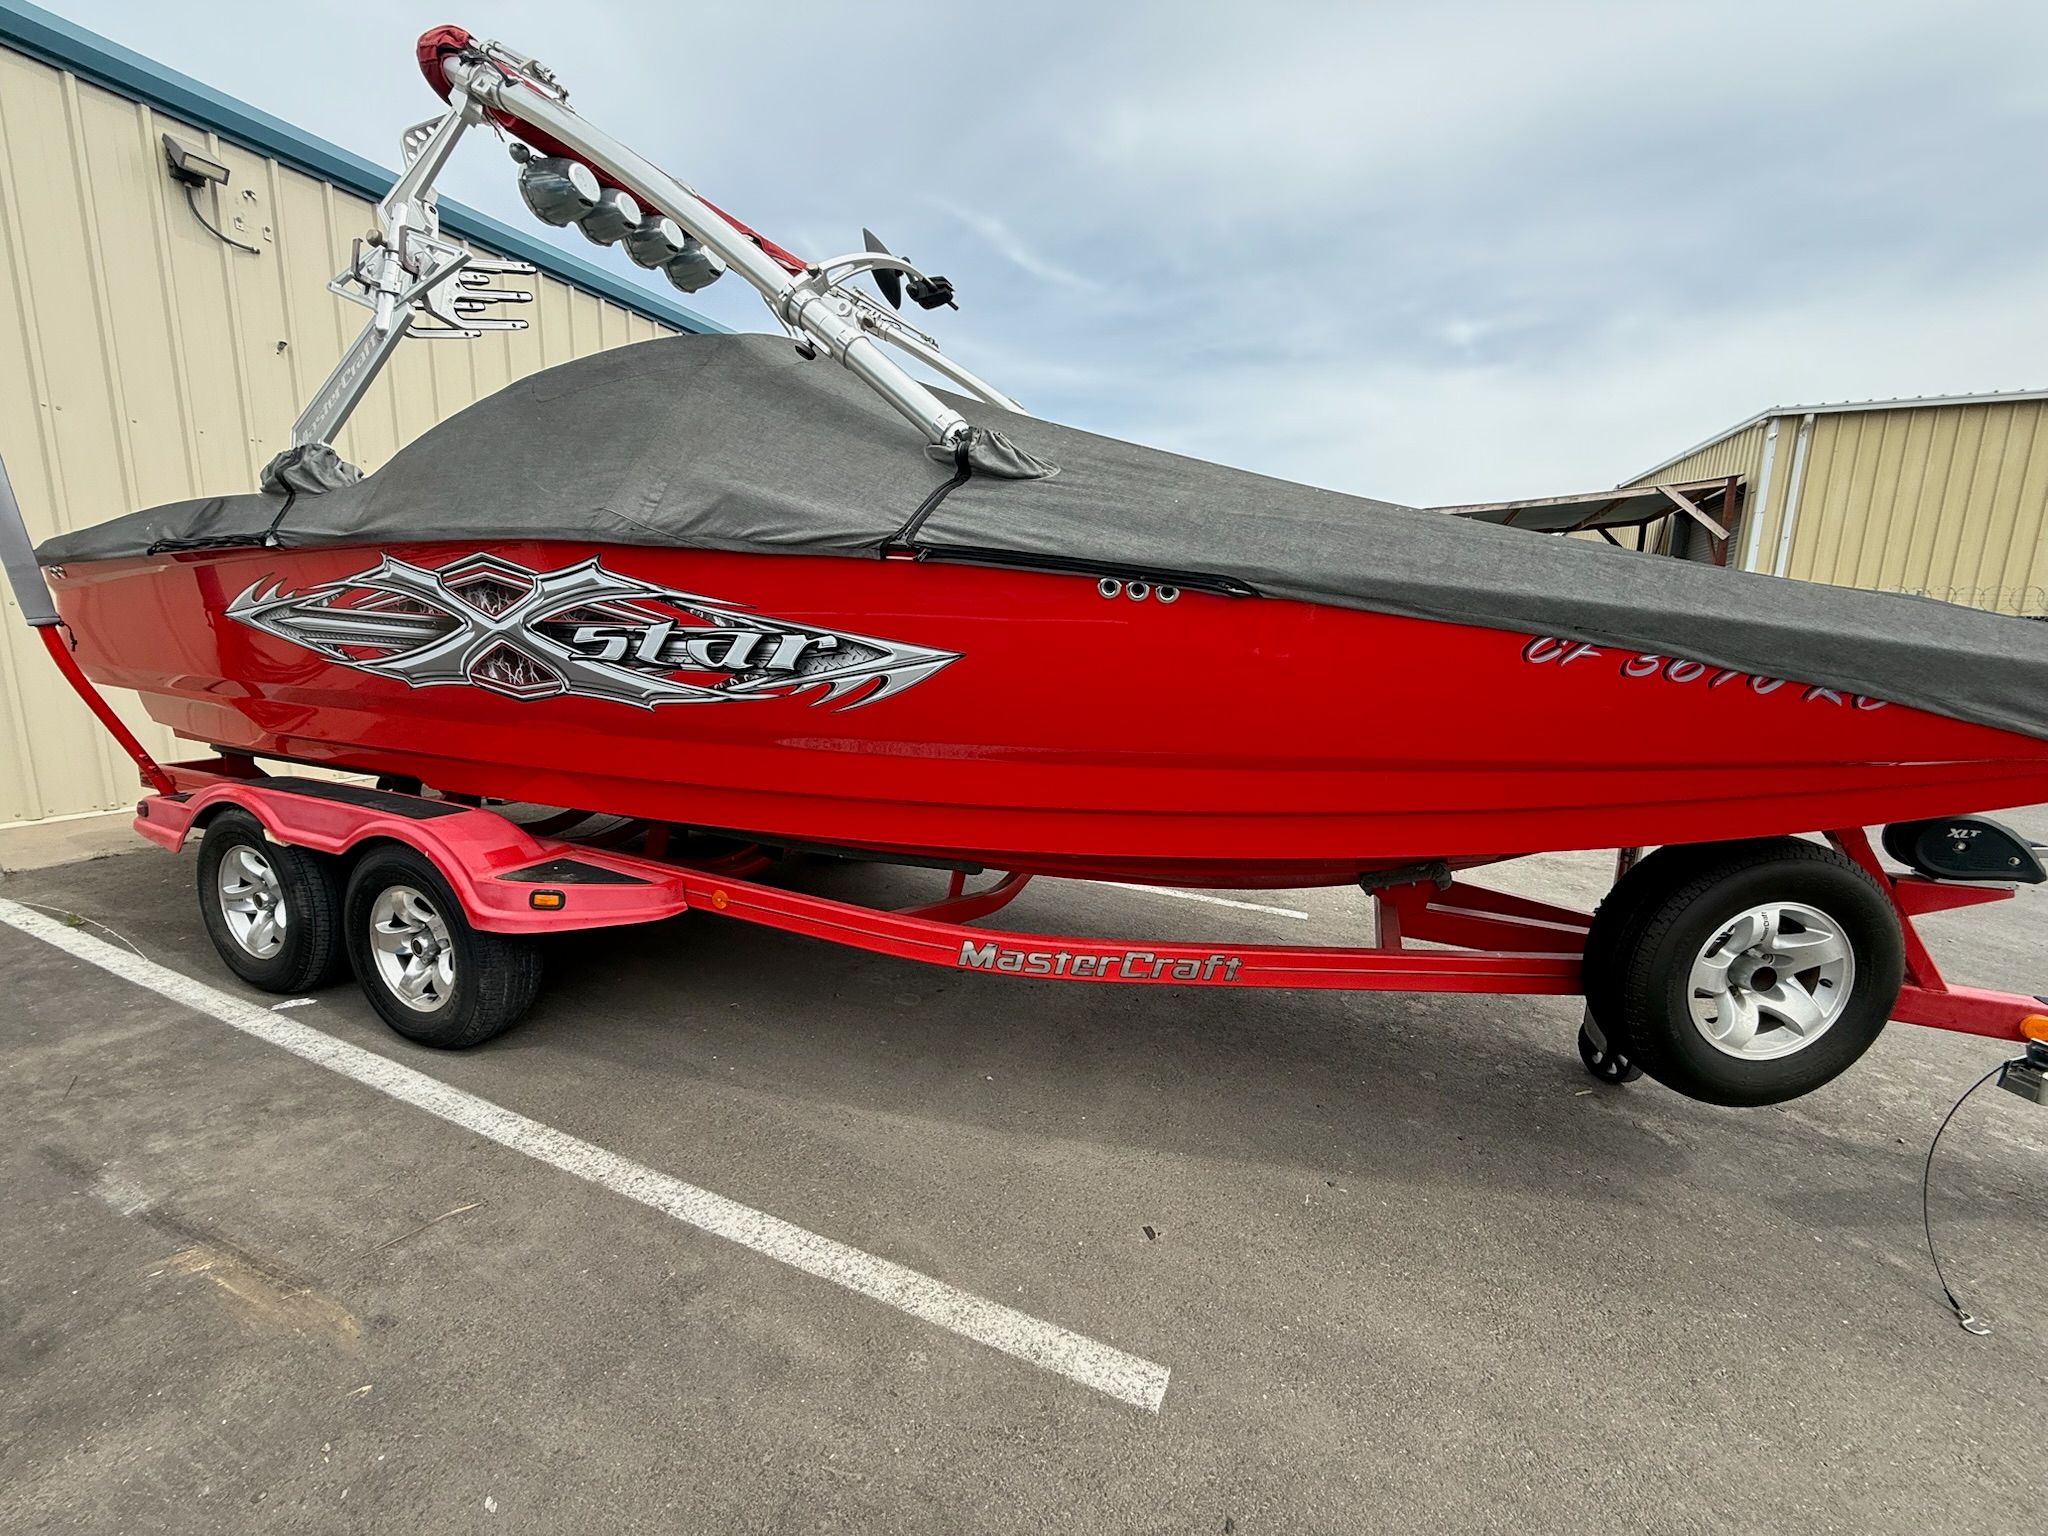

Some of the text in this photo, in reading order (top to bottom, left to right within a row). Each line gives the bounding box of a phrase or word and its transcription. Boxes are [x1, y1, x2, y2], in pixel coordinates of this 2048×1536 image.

[568, 619, 838, 672] star
[1946, 827, 1983, 839] XLT
[958, 939, 1243, 982] MasterCraft
